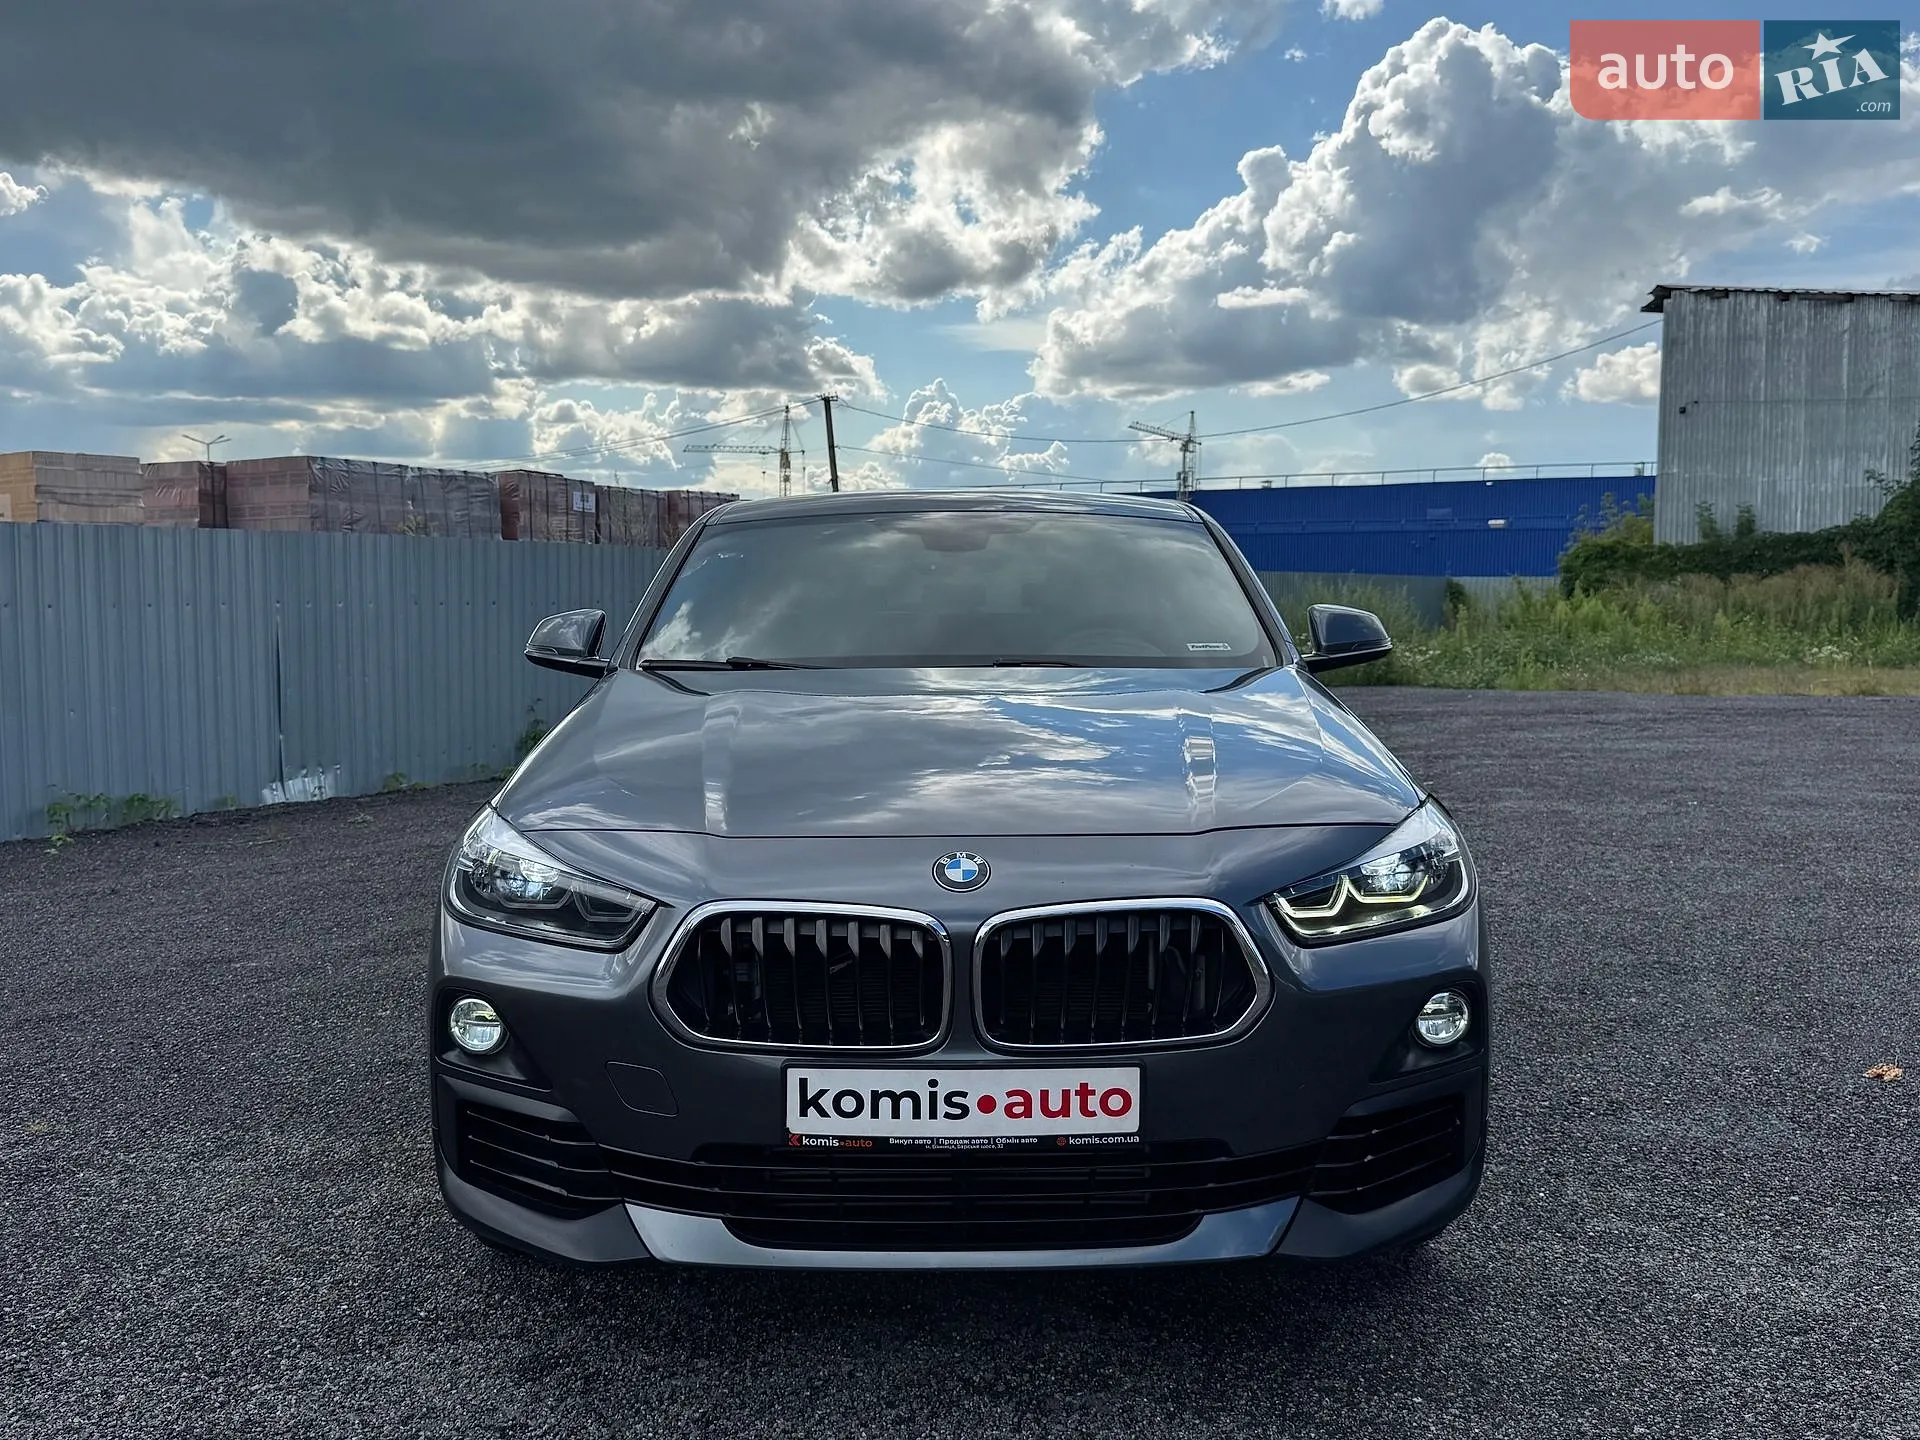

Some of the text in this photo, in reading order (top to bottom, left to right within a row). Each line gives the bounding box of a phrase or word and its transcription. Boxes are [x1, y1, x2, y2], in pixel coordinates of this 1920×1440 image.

[940, 852, 984, 865] BMW
[889, 1137, 913, 1146] Викуп
[939, 1138, 970, 1146] Продаж
[1069, 1135, 1140, 1145] komis.com.ua
